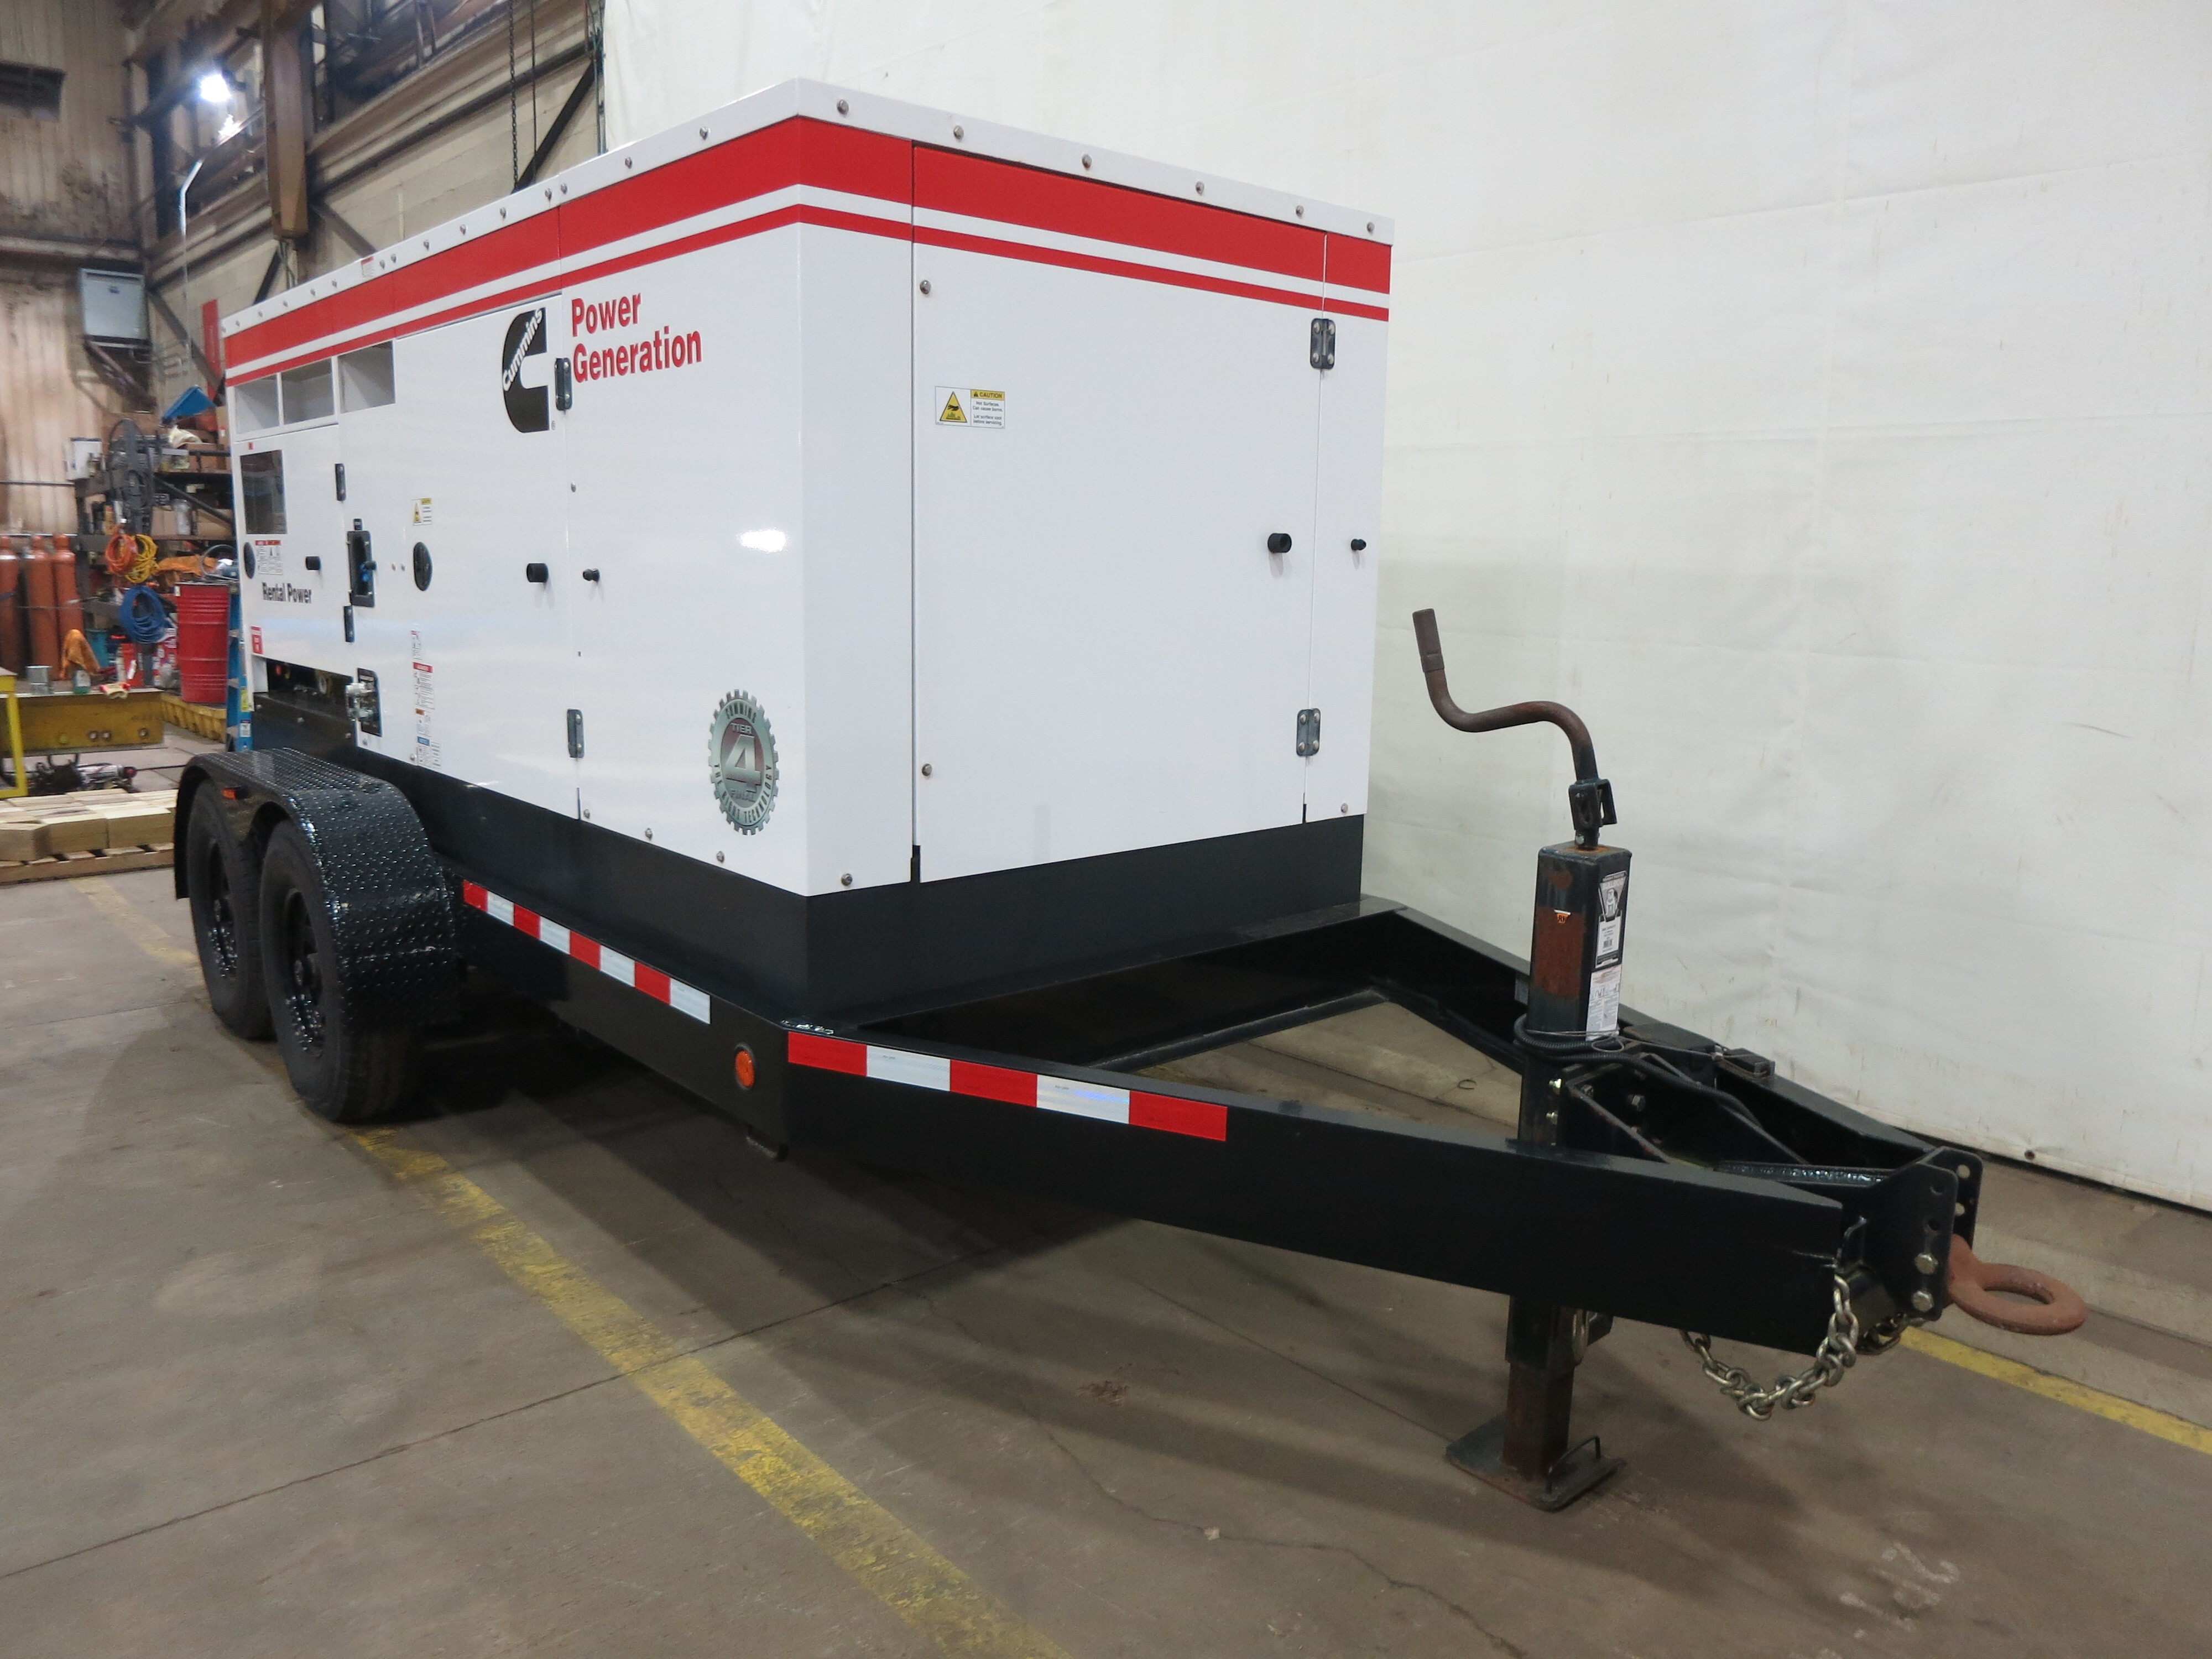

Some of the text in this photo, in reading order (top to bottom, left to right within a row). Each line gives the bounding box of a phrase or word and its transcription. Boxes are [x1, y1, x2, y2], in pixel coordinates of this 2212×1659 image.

[571, 293, 641, 337] Power
[502, 309, 544, 392] Cummins
[573, 326, 702, 383] Generation
[262, 582, 312, 603] Rental Power
[725, 702, 757, 724] CUMMINS
[731, 722, 752, 734] TIER
[726, 734, 762, 792] 4
[744, 765, 773, 823] TECHNOLOGY
